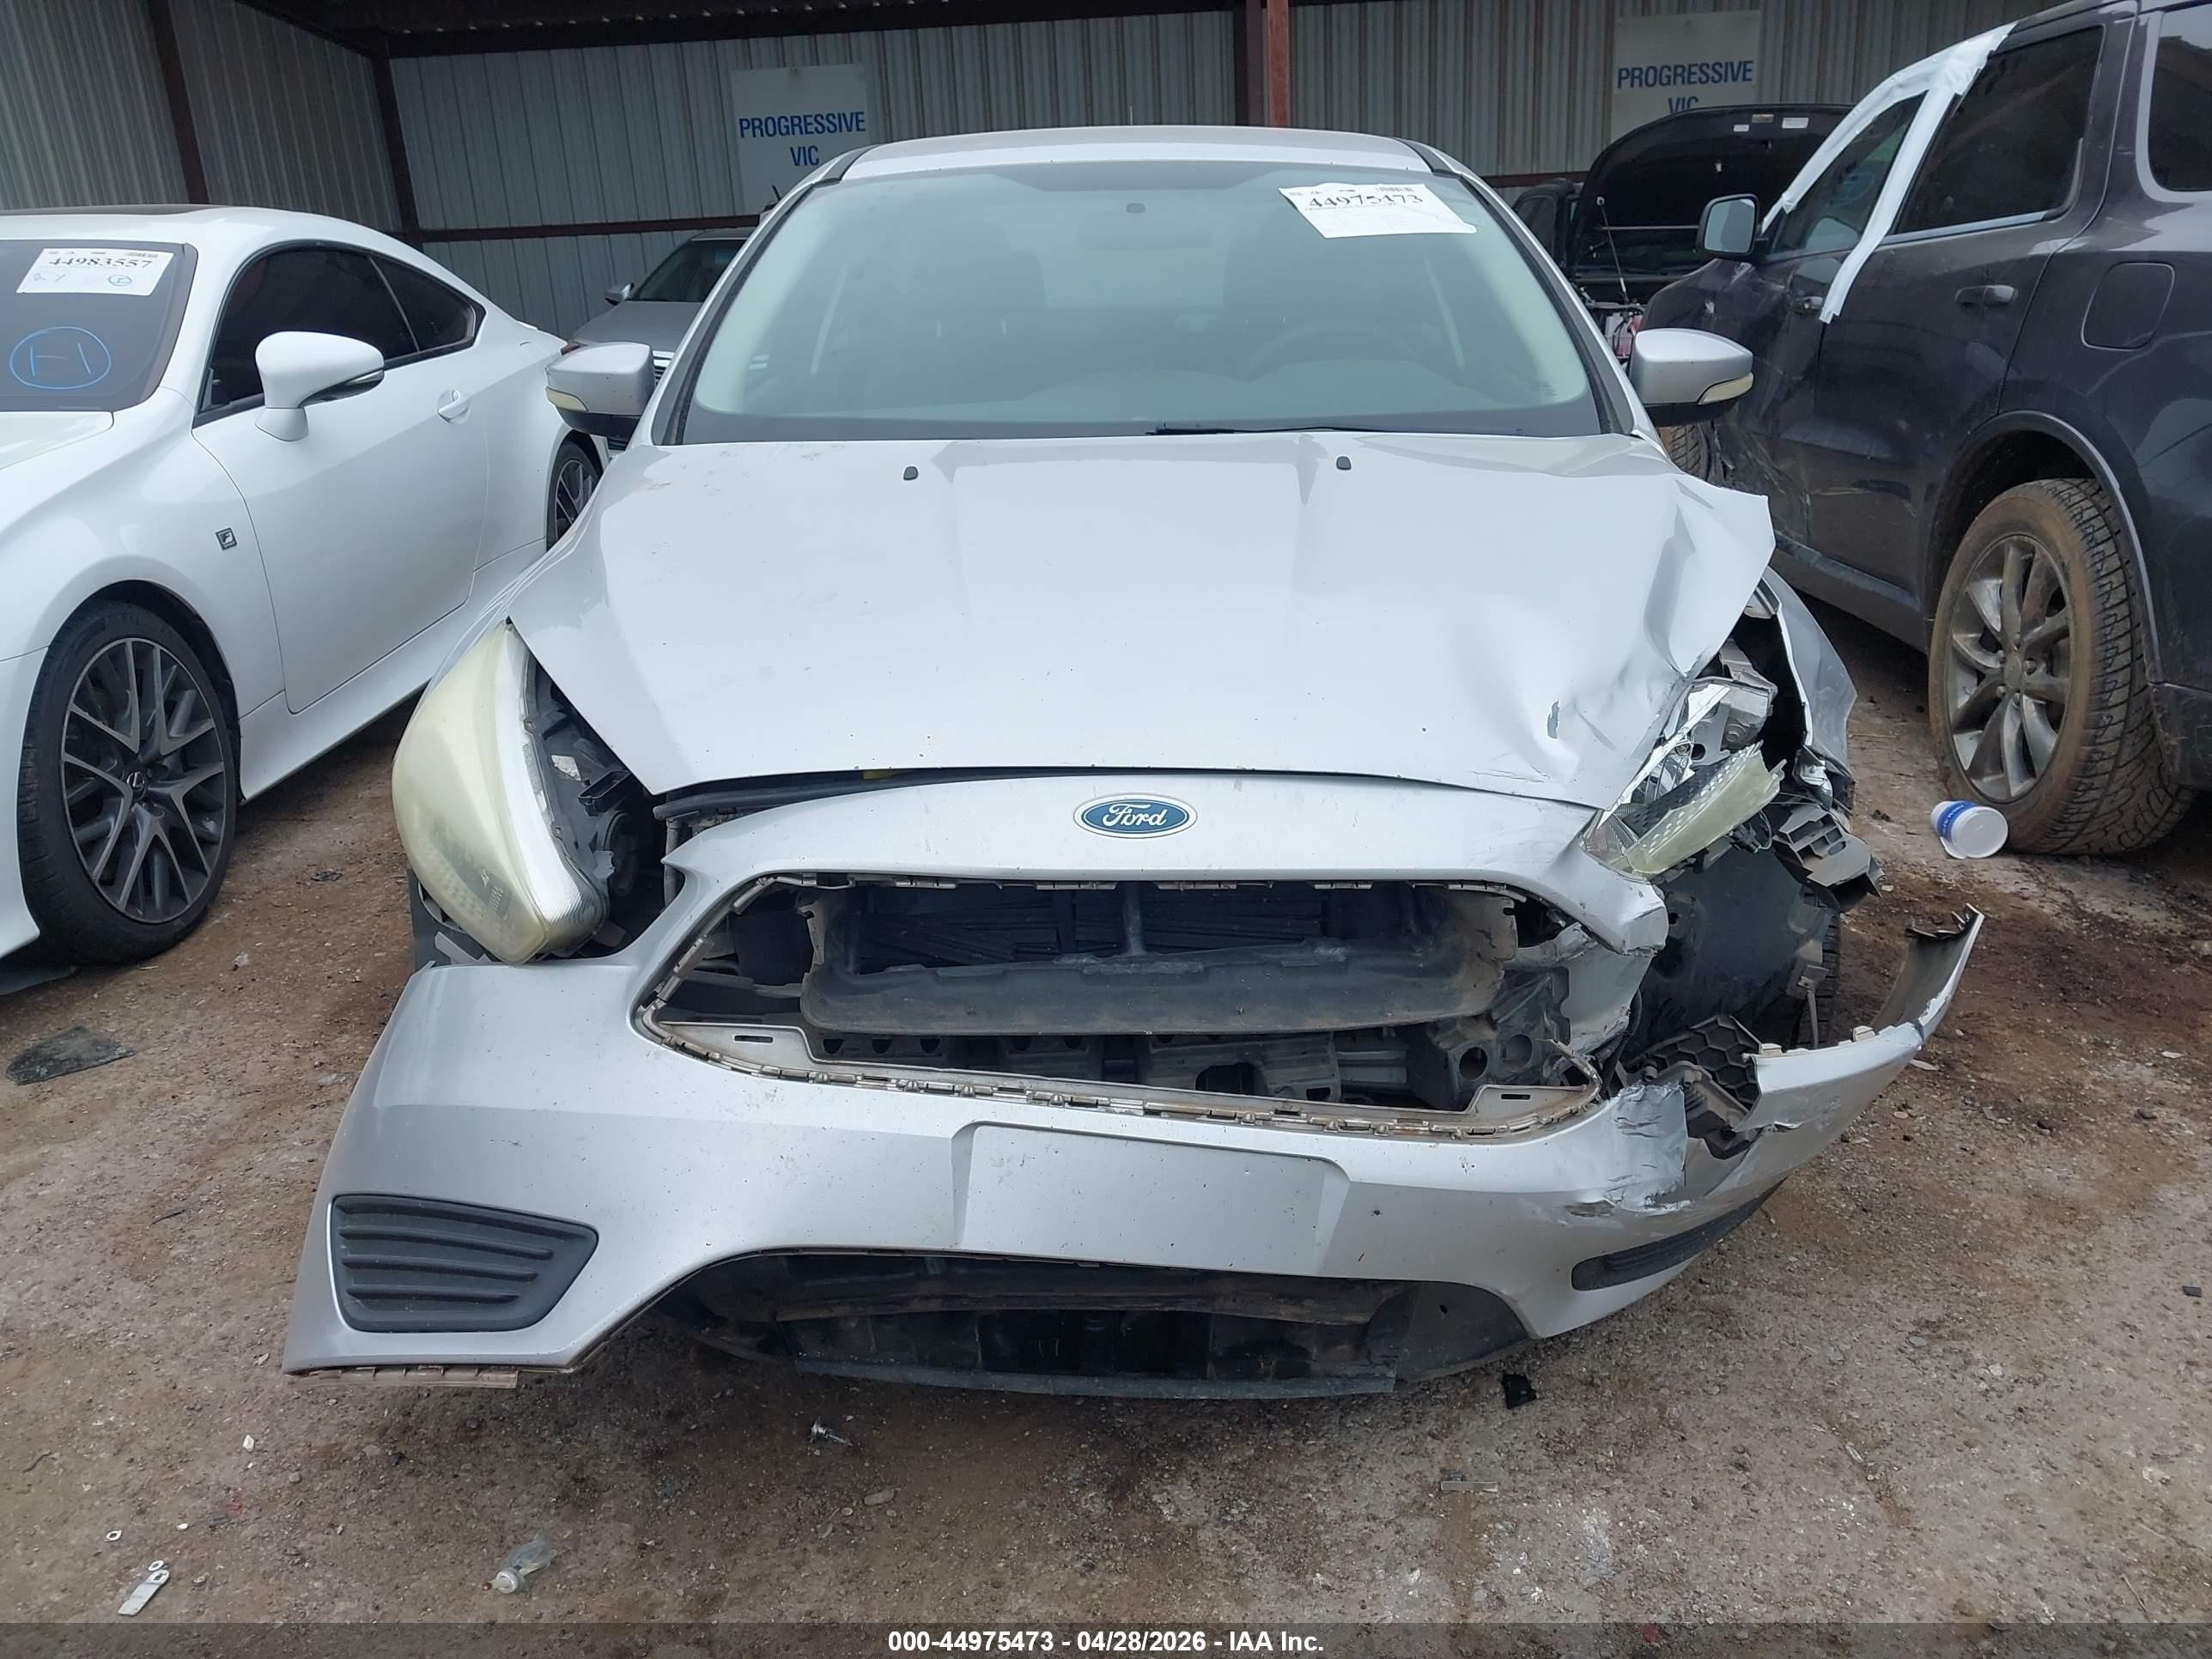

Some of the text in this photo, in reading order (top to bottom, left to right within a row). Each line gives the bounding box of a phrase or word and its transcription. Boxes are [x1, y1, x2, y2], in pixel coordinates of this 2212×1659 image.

[1617, 60, 1754, 88] PROGRESSIVE
[738, 111, 866, 138] PROGRESSIVE
[790, 145, 820, 167] VIC
[1309, 193, 1424, 208] 44975473
[47, 257, 153, 268] 44983557
[1102, 803, 1168, 827] Ford
